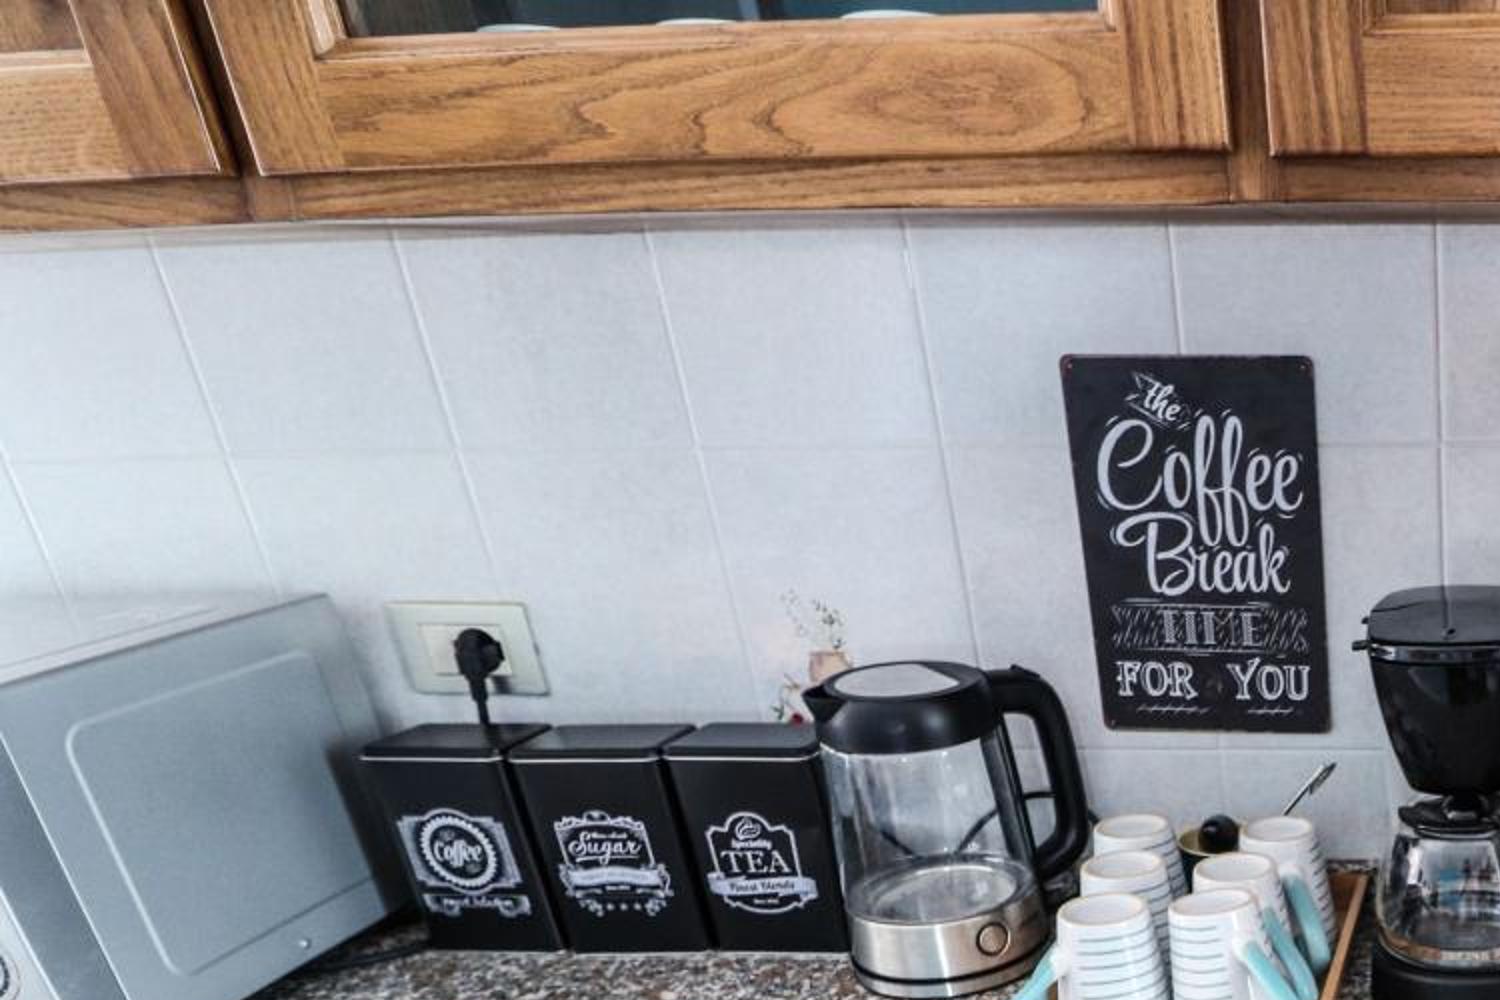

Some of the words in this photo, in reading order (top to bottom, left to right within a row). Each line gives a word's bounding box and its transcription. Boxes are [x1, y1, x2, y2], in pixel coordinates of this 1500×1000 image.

[1143, 382, 1180, 422] the
[1097, 415, 1303, 547] Coffee
[1116, 511, 1291, 596] Break
[1159, 610, 1265, 647] TIME
[1116, 661, 1198, 700] FOR
[1227, 657, 1310, 700] YOU
[433, 838, 483, 868] Coffee
[568, 831, 642, 866] Sugar
[720, 850, 791, 873] TEA
